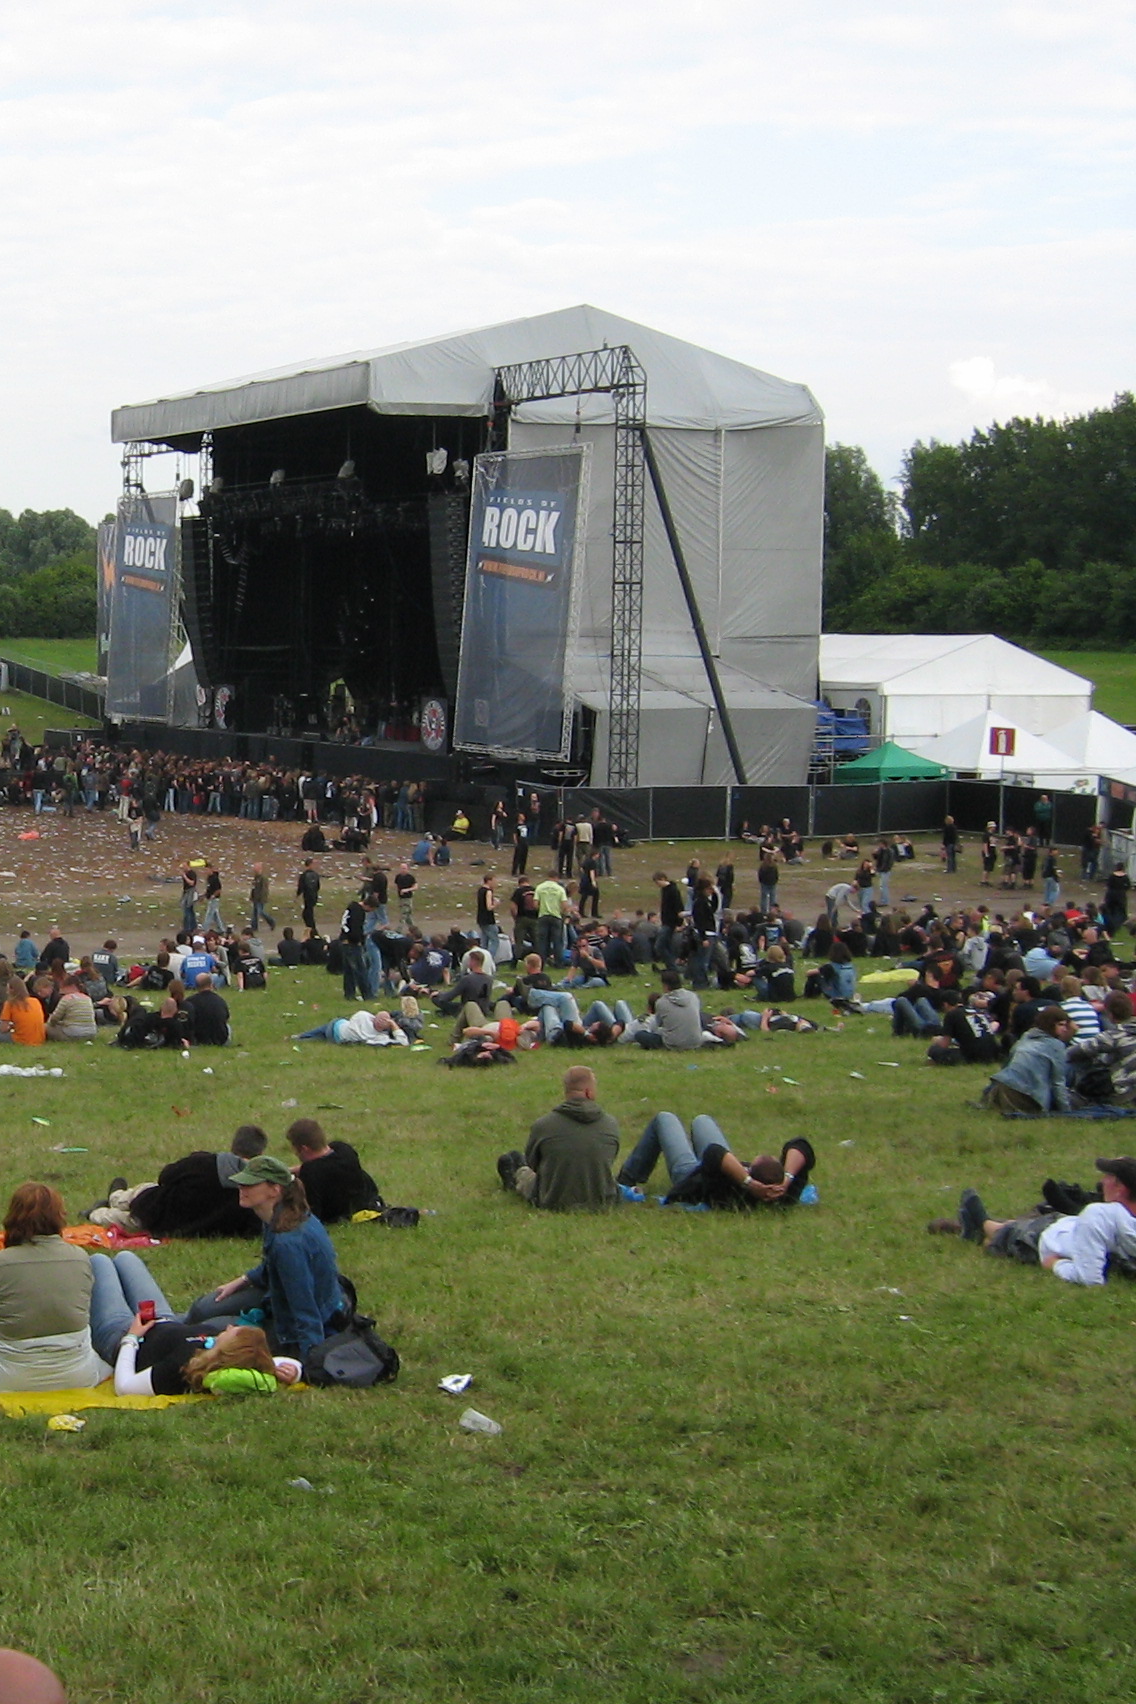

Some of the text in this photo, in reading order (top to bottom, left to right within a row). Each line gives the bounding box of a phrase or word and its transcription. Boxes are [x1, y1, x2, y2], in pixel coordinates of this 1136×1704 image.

[489, 496, 557, 508] FIELDS OF
[482, 506, 560, 554] ROCK
[123, 534, 167, 571] ROCK
